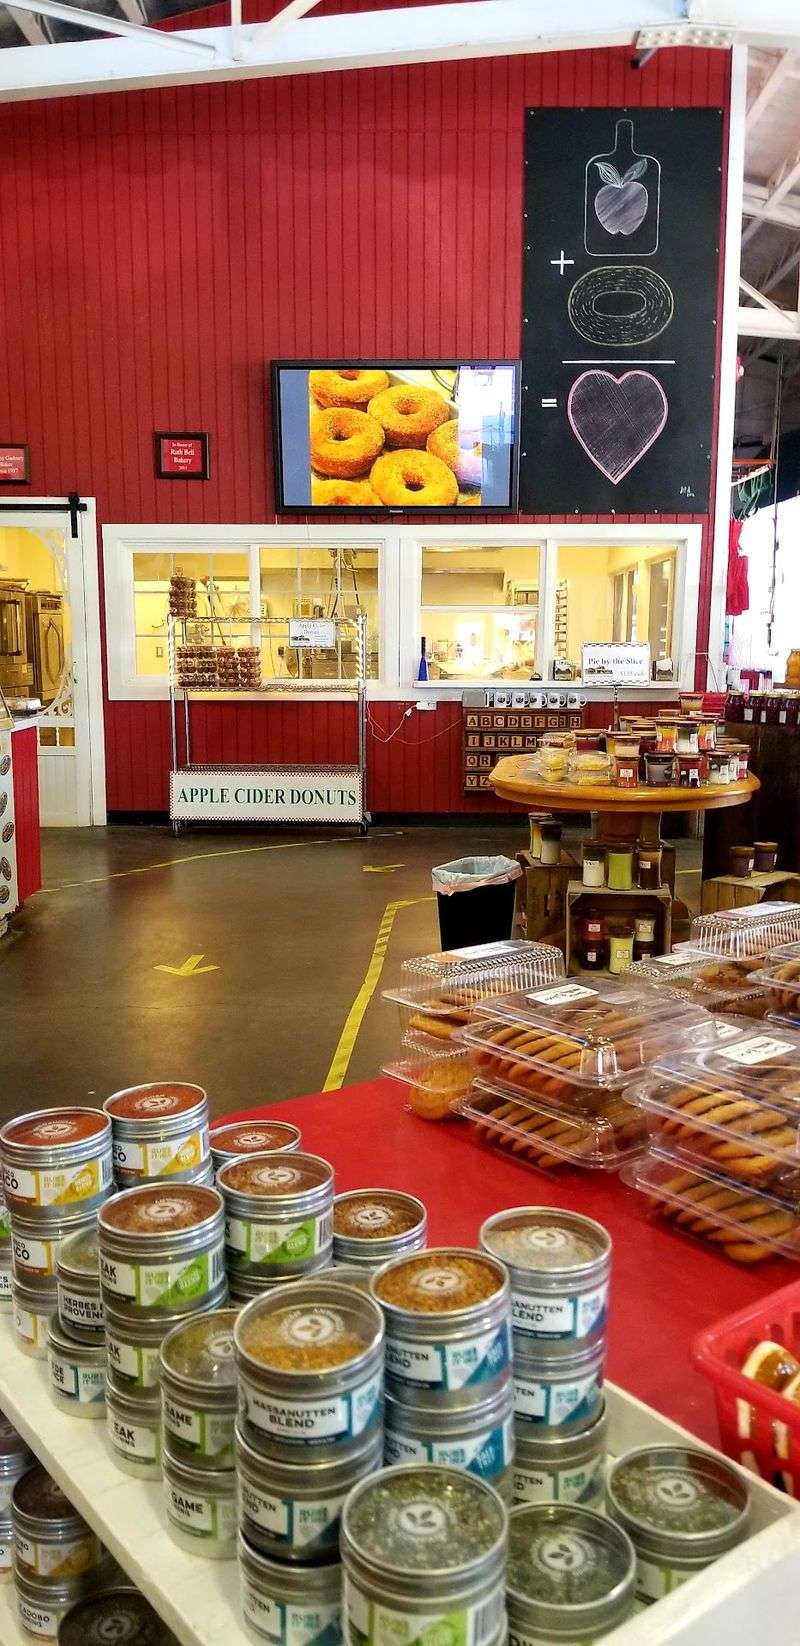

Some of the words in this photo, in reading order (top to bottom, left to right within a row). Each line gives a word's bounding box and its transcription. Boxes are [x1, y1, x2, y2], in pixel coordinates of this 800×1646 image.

[588, 657, 598, 665] Pie
[601, 657, 610, 666] by
[612, 657, 624, 665] the
[625, 657, 643, 665] Slice
[178, 788, 229, 804] APPLE
[234, 788, 285, 805] CIDER
[290, 789, 356, 806] DONUTS
[63, 1294, 97, 1311] HERBES
[252, 1398, 337, 1419] MASSANUTTEN
[268, 1414, 316, 1430] BLEND
[171, 1490, 204, 1515] GAME
